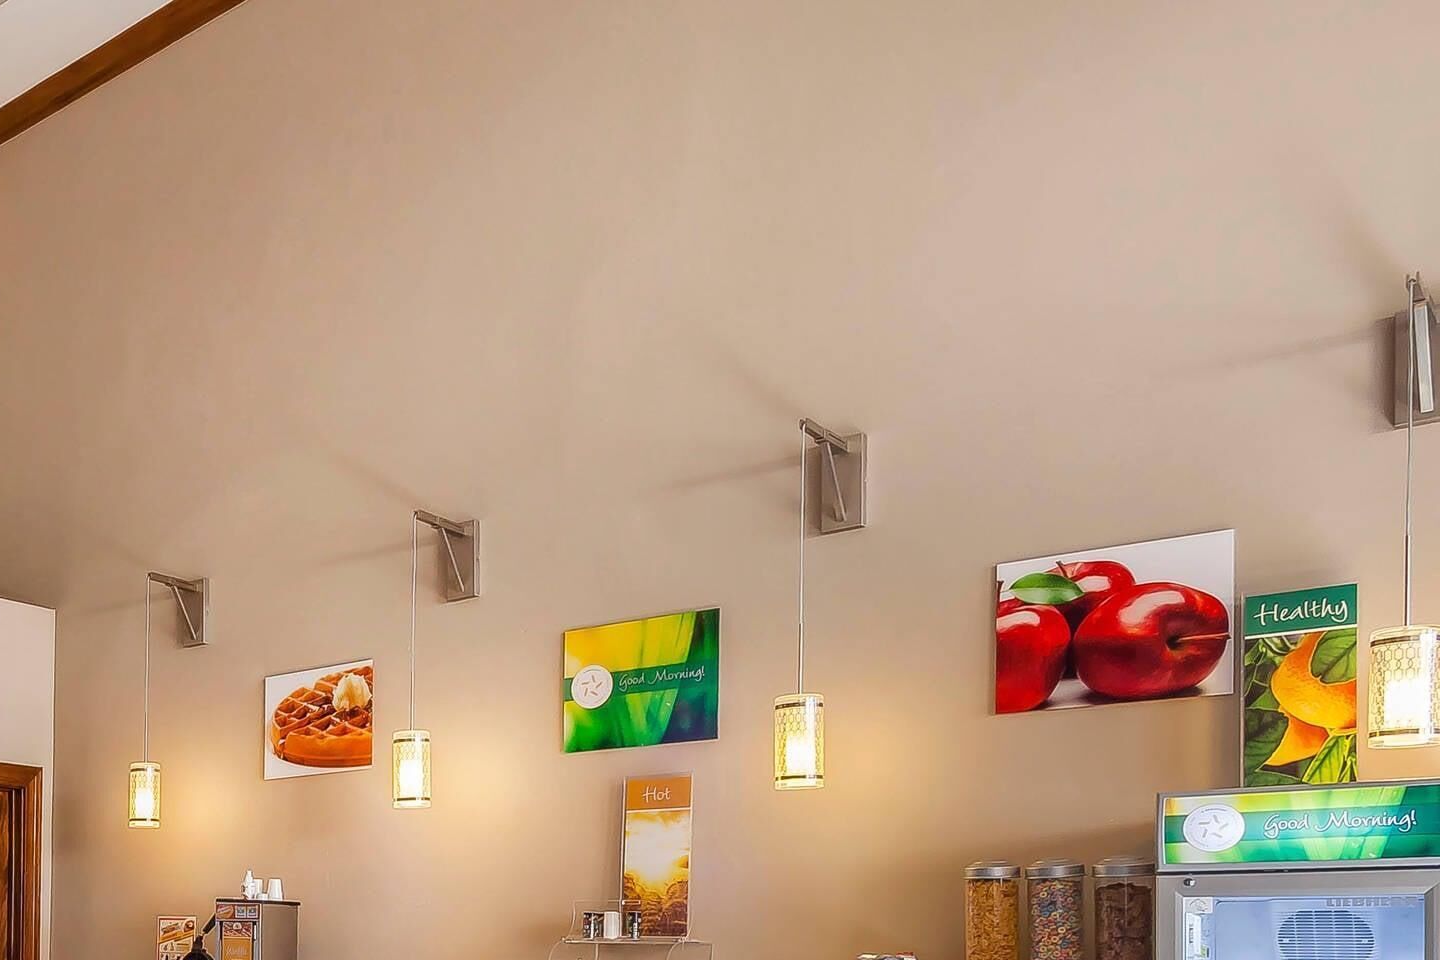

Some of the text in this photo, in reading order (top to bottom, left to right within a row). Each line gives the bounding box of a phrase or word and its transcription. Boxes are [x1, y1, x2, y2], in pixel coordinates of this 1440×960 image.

[1253, 598, 1348, 626] Healthy
[618, 665, 705, 692] Good Morning!
[642, 784, 671, 803] Hot
[1263, 809, 1417, 839] Good Morning!
